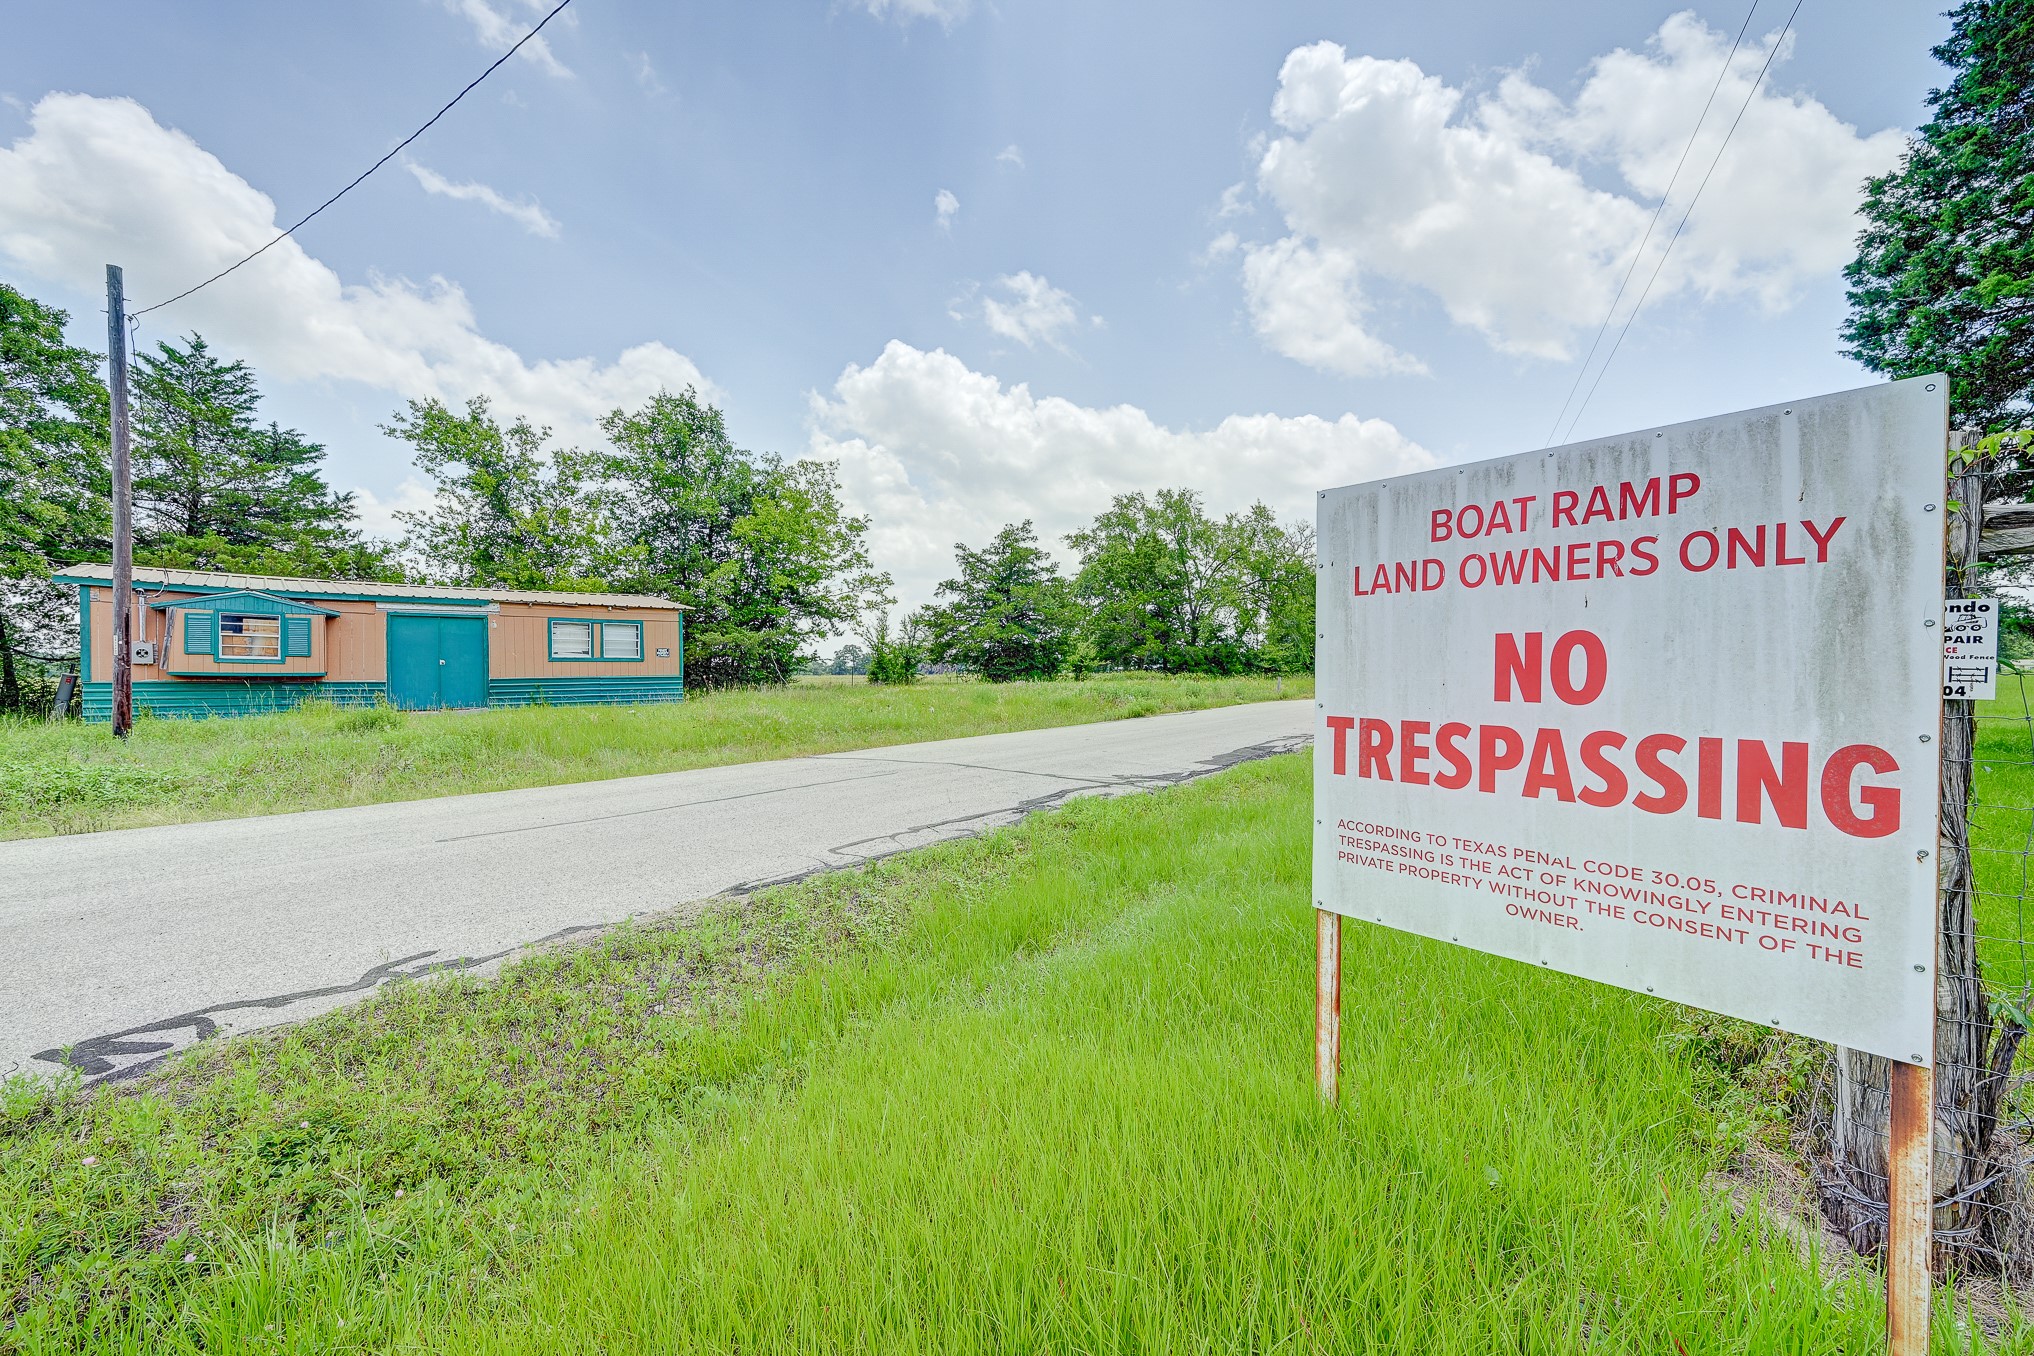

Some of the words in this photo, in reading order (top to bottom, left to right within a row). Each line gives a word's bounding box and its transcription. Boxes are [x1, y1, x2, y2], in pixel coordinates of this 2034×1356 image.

[1431, 496, 1536, 543] BOAT
[1552, 472, 1701, 529] RAMP
[1354, 559, 1445, 597] LAND
[1459, 533, 1659, 589] OWNERS
[1680, 516, 1846, 573] ONLY
[1944, 601, 1990, 613] ndo
[1493, 629, 1608, 707] NO
[1326, 715, 1902, 839] TRESPASSING
[1338, 818, 1421, 842] ACCORDING
[1426, 833, 1447, 847] TO
[1452, 838, 1507, 858] TEXAS
[1513, 848, 1576, 870] PENAL
[1583, 860, 1644, 882] CODE
[1652, 870, 1722, 898] 30.05,
[1732, 884, 1870, 920] CRIMINAL
[1338, 851, 1394, 872] PRIVATE
[1399, 863, 1482, 890] PROPERTY
[1489, 881, 1578, 910] WITHOUT
[1585, 900, 1625, 920] THE
[1633, 910, 1749, 944] CONSENT
[1759, 935, 1796, 952] OF
[1806, 943, 1863, 968] THE
[1339, 835, 1434, 863] TRESPASSING
[1440, 854, 1454, 866] IS
[1459, 857, 1492, 874] THE
[1498, 864, 1533, 881] ACT
[1540, 872, 1566, 887] OF
[1574, 878, 1711, 914] KNOWINGLY
[1721, 904, 1862, 943] ENTERING
[1506, 903, 1584, 931] OWNER.
